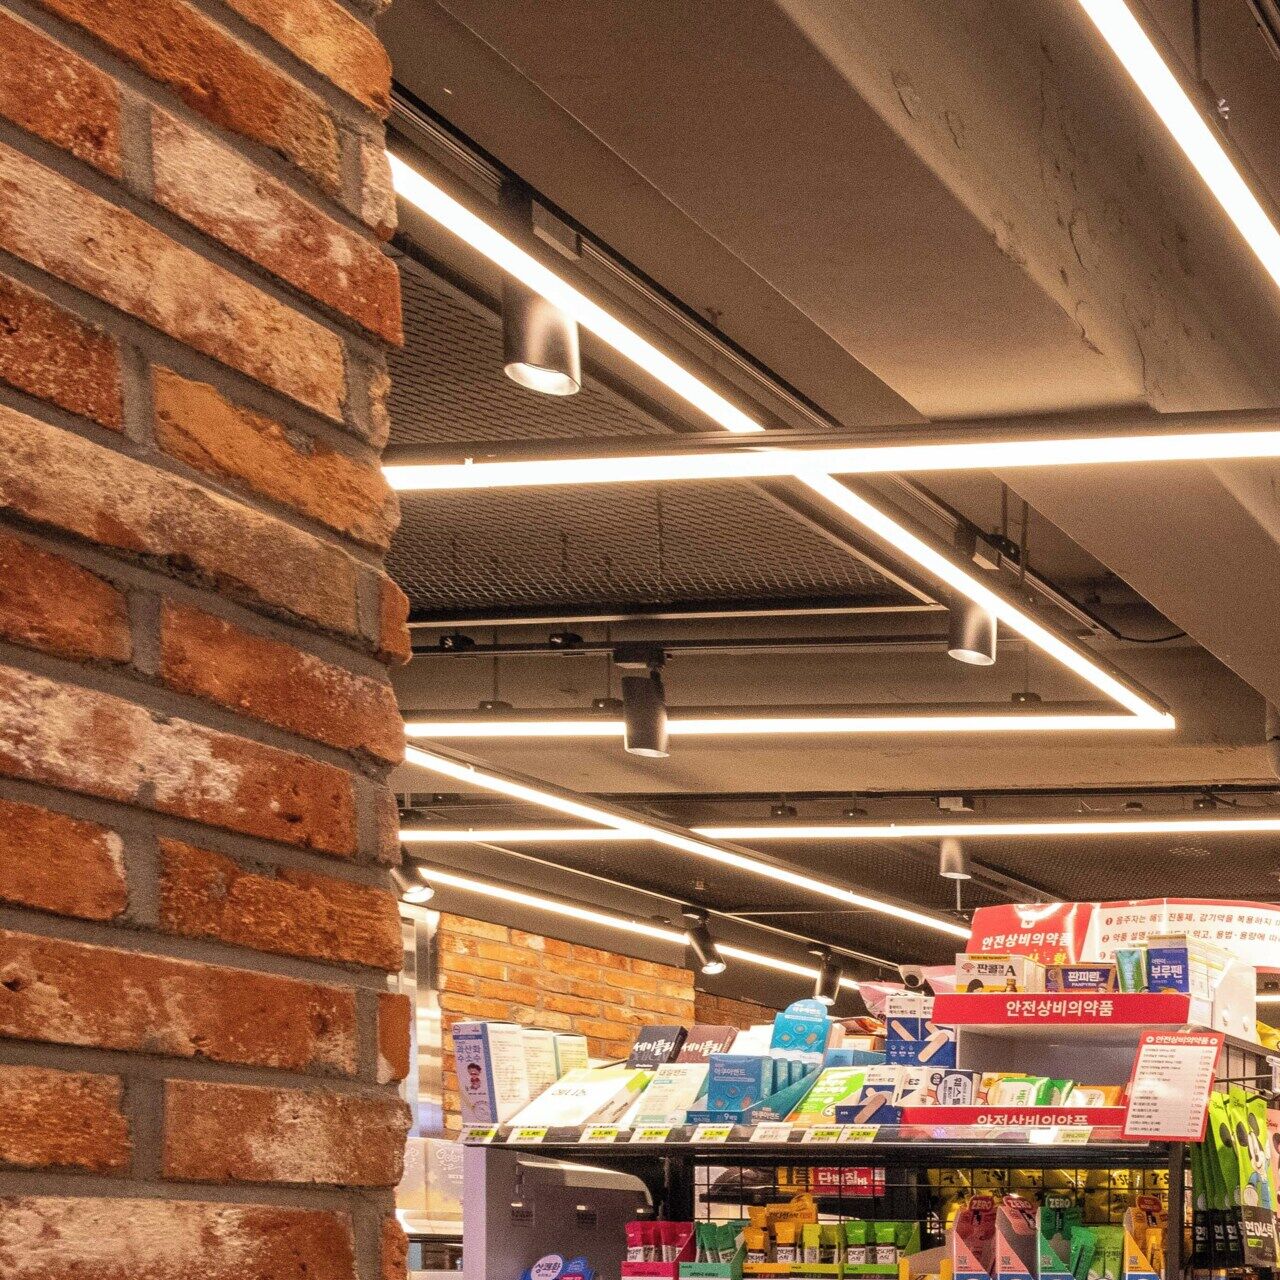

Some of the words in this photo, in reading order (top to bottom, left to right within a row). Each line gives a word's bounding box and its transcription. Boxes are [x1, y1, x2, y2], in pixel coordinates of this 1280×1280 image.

[1116, 913, 1145, 926] 음주자는
[1199, 913, 1233, 923] 감기약을
[1237, 914, 1273, 926] 복용하지
[981, 931, 1074, 950] 안전상비의약품
[1151, 965, 1184, 978] 부루펜
[1006, 1000, 1114, 1018] 안전상비의약품
[972, 1200, 993, 1210] ZERO
